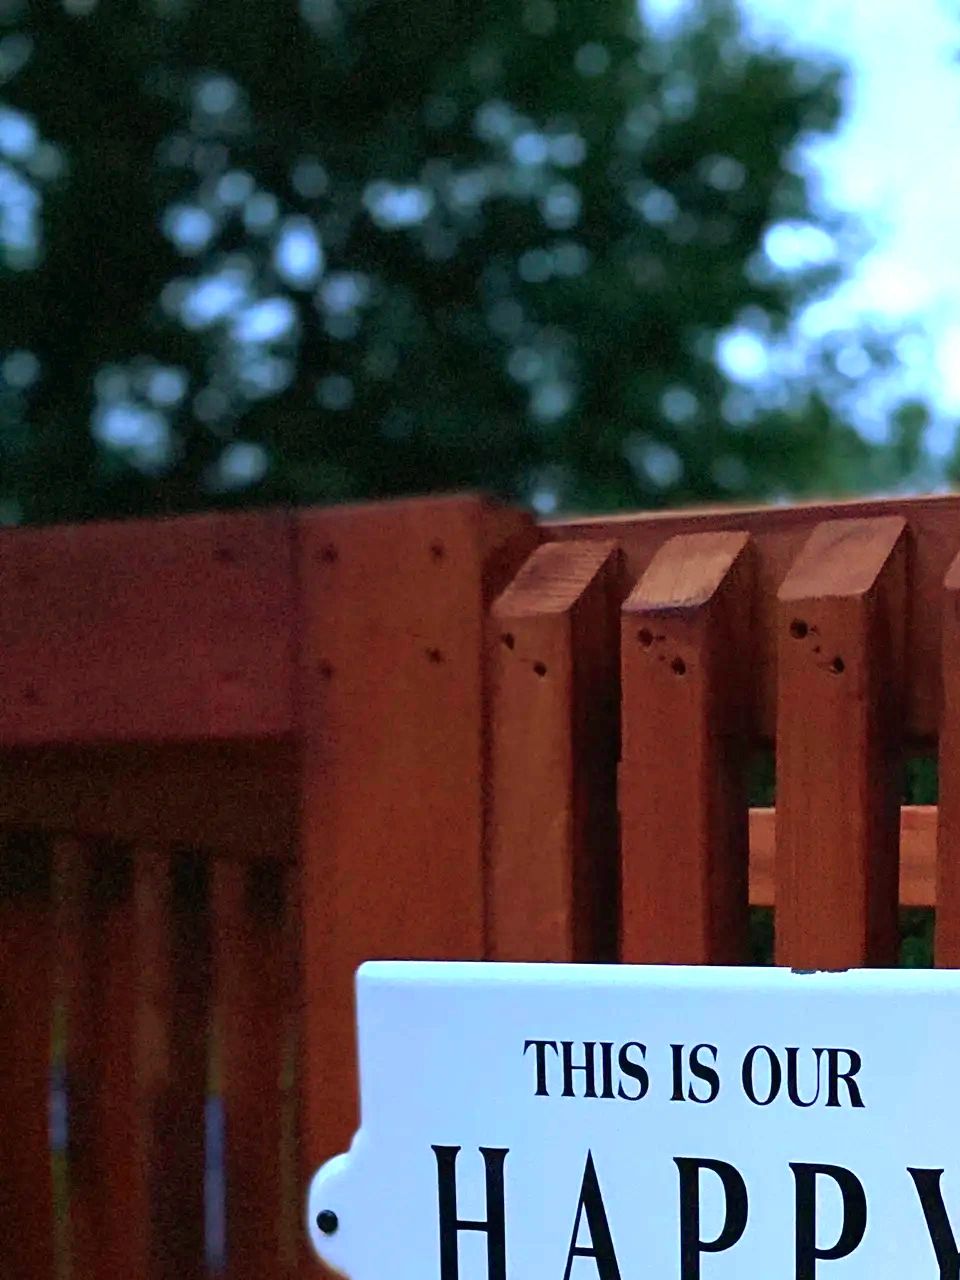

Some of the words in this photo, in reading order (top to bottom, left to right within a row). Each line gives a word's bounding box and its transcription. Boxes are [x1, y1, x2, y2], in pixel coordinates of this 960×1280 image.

[522, 1039, 649, 1102] THIS
[669, 1043, 720, 1104] IS
[741, 1045, 866, 1108] OUR
